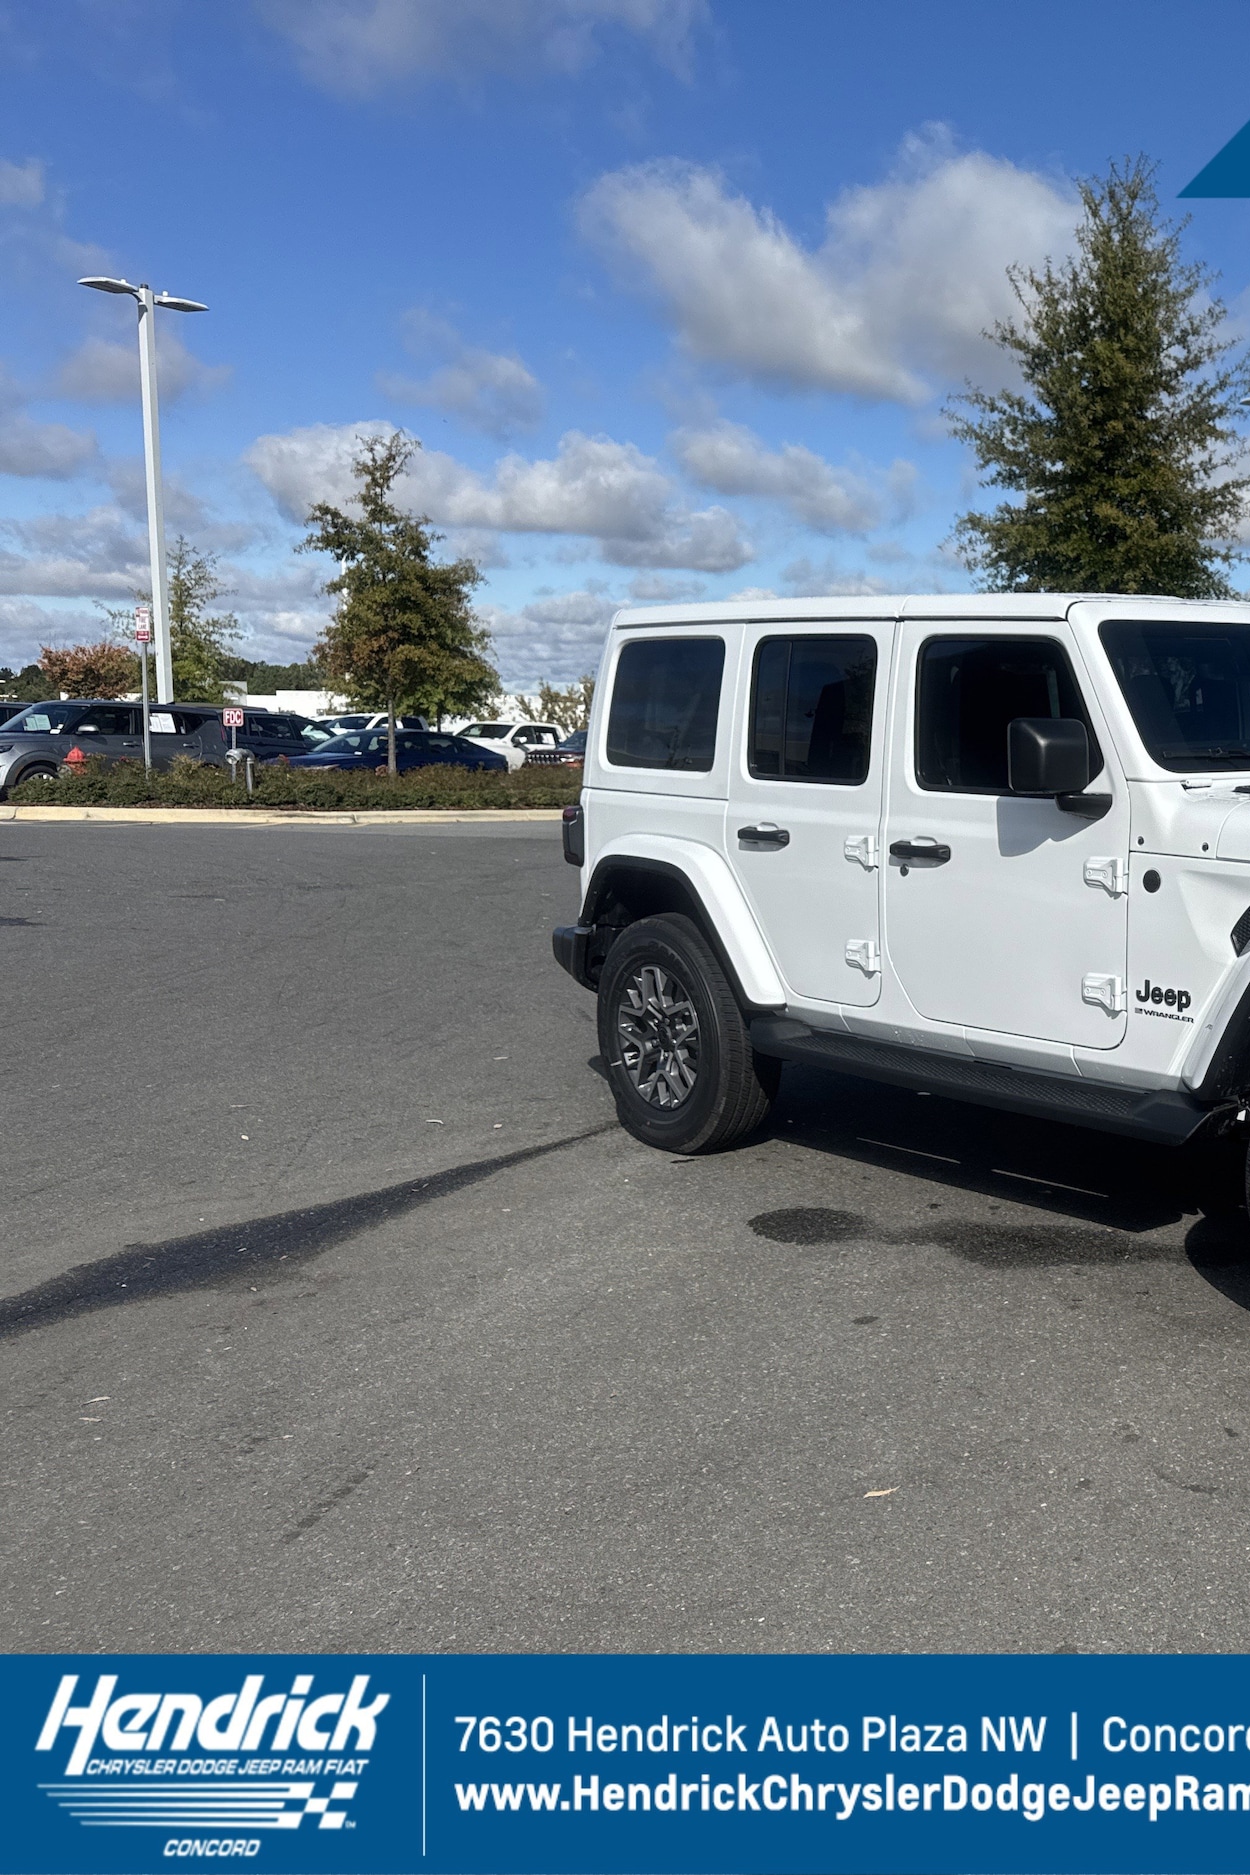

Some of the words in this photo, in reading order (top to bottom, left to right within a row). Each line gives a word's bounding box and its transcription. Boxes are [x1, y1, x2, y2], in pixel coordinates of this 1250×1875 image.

[225, 710, 242, 724] FDC
[1136, 979, 1191, 1012] Jeep
[1143, 1008, 1195, 1024] WRANGLER
